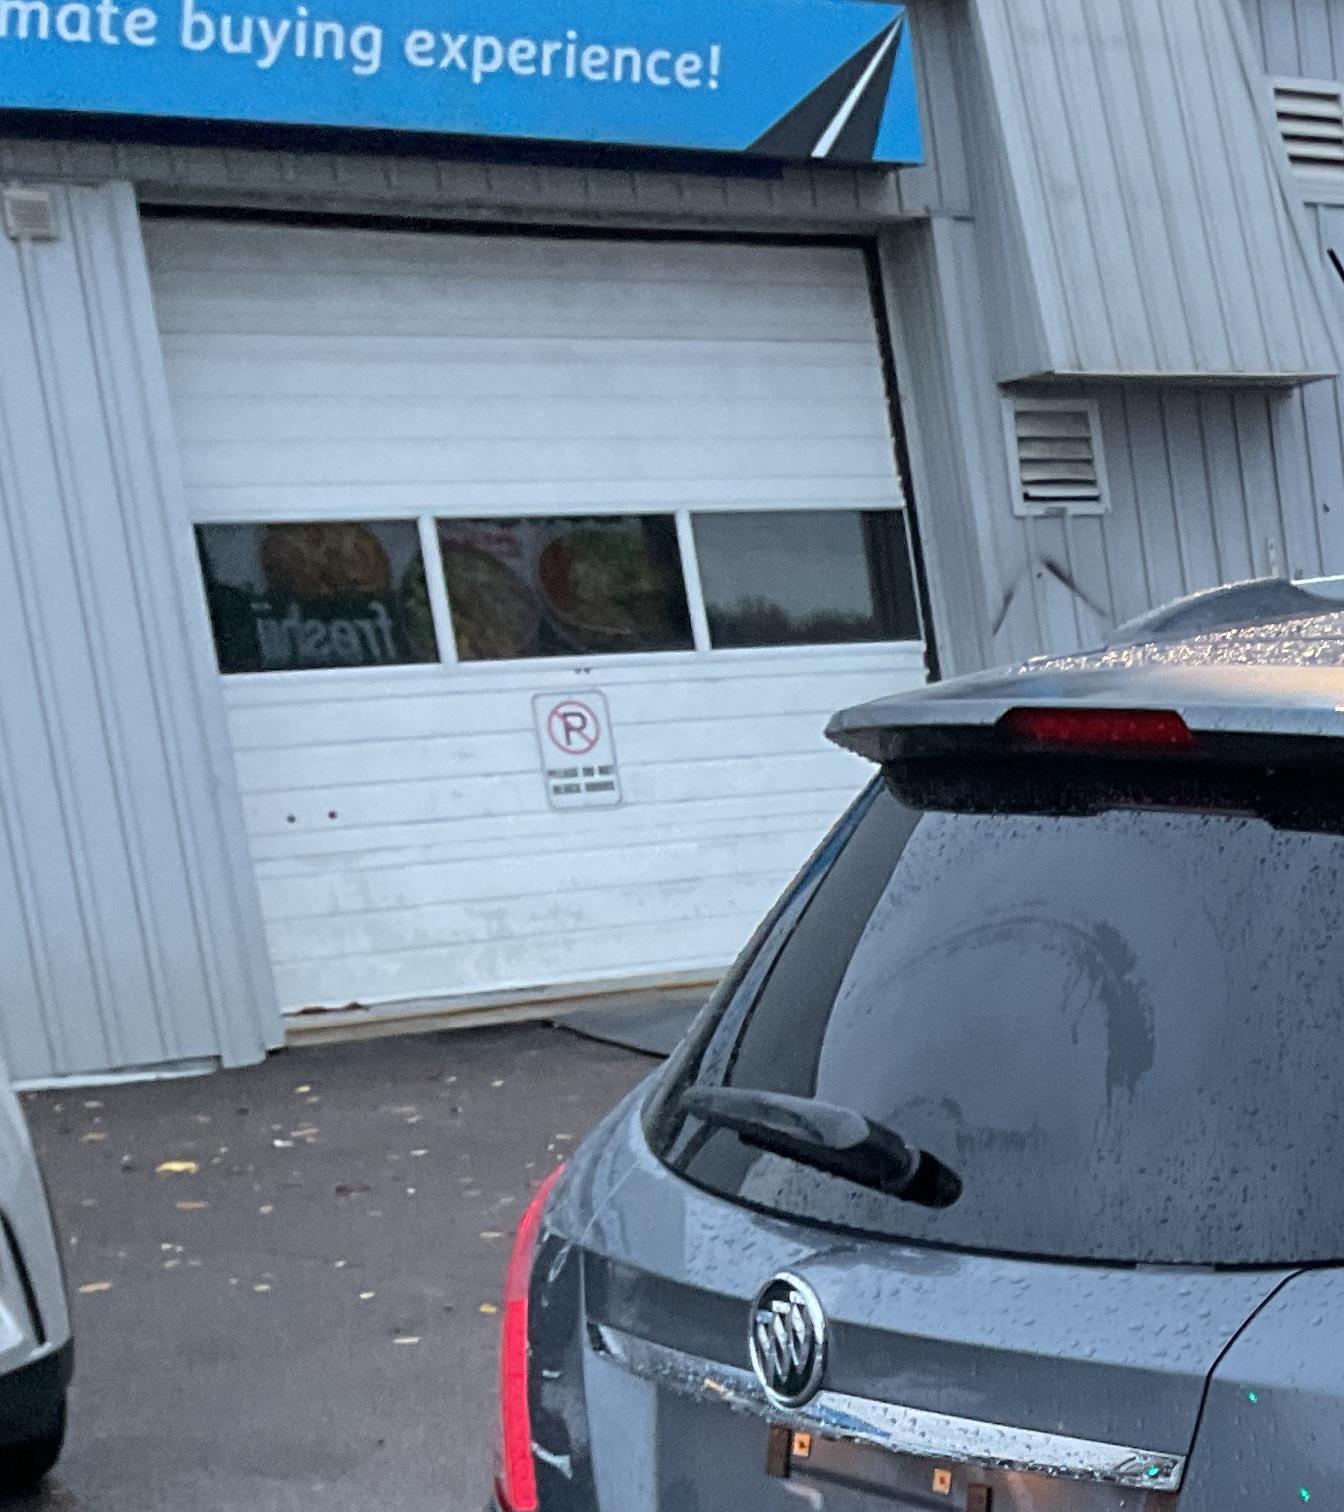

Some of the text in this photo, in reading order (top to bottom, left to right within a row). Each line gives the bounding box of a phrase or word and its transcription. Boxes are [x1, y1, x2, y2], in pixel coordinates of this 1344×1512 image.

[0, 0, 721, 90] mate buying experience!
